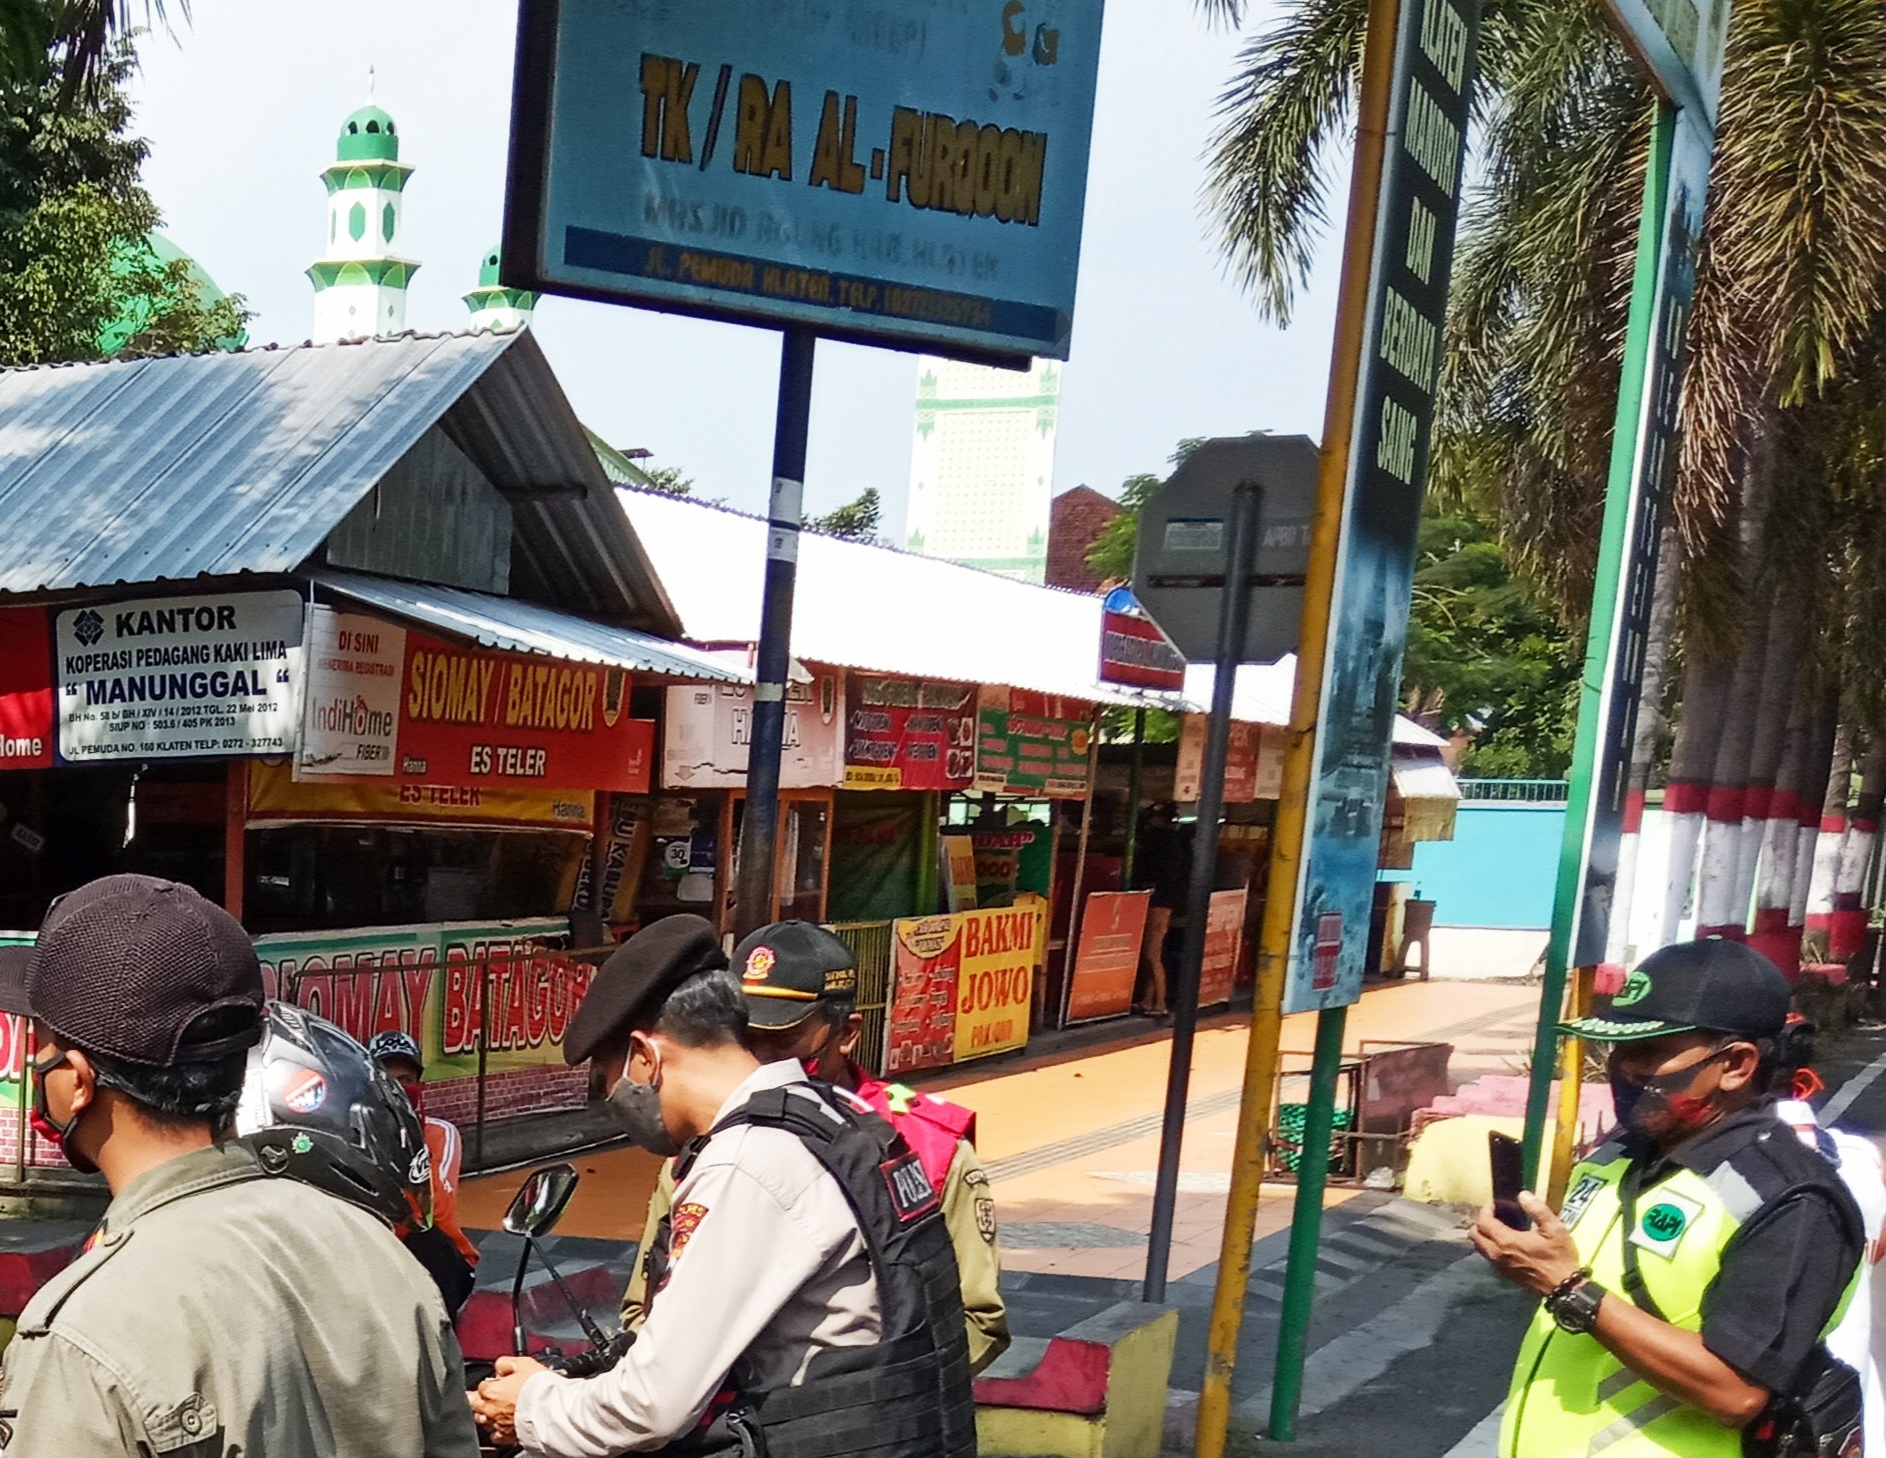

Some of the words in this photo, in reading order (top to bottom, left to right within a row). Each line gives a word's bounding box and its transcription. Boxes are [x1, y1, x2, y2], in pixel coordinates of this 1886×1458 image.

[1420, 0, 1468, 96] KLATEN
[639, 52, 700, 164] TK
[699, 64, 732, 171] /
[733, 72, 792, 182] RA
[1404, 76, 1460, 199] MANDIRI
[1406, 196, 1436, 285] DAN
[1380, 286, 1437, 395] BERDAYA
[1377, 395, 1418, 485] SAING
[115, 605, 237, 638] KANTOR
[66, 650, 132, 675] KOPERASI
[136, 645, 210, 668] PEDAGANG
[214, 642, 248, 663] KAKI
[252, 640, 287, 660] LIMA
[338, 634, 353, 654] DI
[355, 633, 379, 654] SINI
[85, 669, 267, 706] MANUNGGAL
[257, 702, 278, 713] 2012
[408, 651, 495, 724] SIOMAY
[493, 662, 507, 726] /
[506, 664, 599, 731] BATAGOR
[214, 717, 236, 727] 2013
[312, 694, 392, 737] IndiHome
[81, 744, 119, 755] PEMUDA
[156, 740, 192, 752] KLATEN
[356, 744, 381, 761] FIBER
[401, 756, 427, 775] Hanna
[470, 745, 492, 774] ES
[497, 747, 547, 777] TELER
[551, 801, 586, 820] Hanna
[600, 841, 630, 926] KABUPA
[964, 911, 1034, 958] BAKMI
[444, 940, 600, 1055] BATAGOR
[961, 965, 1029, 1014] JOWO
[1568, 1178, 1600, 1207] 24
